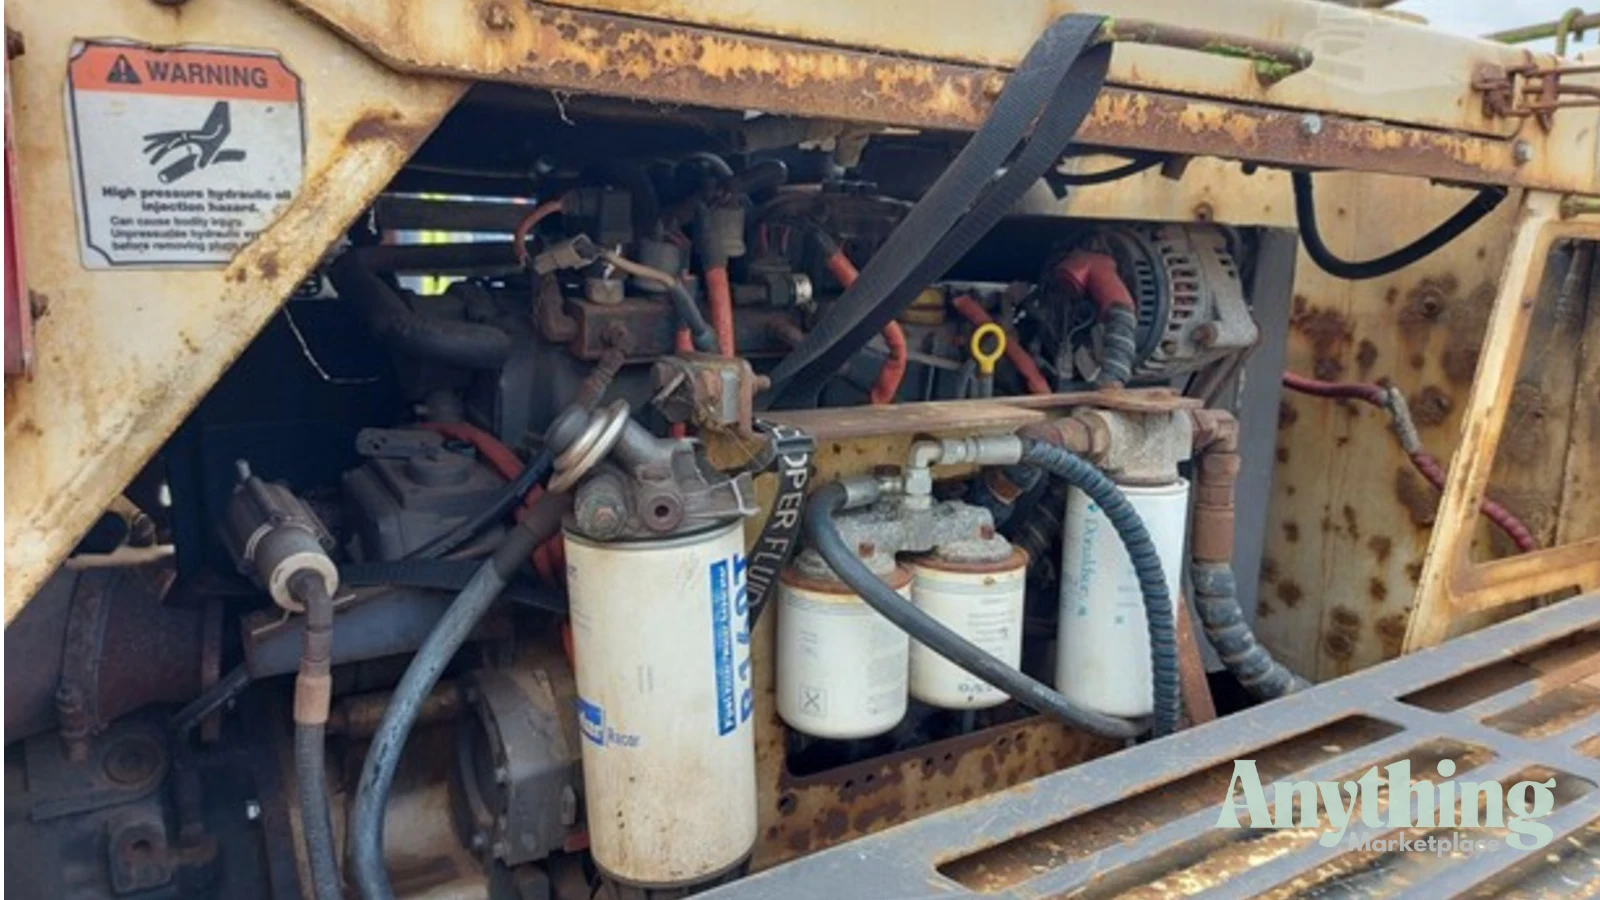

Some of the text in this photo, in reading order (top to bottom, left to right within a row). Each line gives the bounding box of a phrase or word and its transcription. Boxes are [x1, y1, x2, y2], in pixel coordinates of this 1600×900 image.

[145, 60, 269, 88] WARNING
[102, 186, 292, 201] High pressure hydraulic oil
[141, 200, 259, 214] injection hazard.
[110, 216, 134, 226] Can
[136, 217, 171, 226] cause
[173, 216, 208, 228] bodily
[190, 229, 240, 240] hydraulic
[111, 240, 149, 251] before
[152, 241, 206, 253] removing
[747, 536, 790, 608] FLUID
